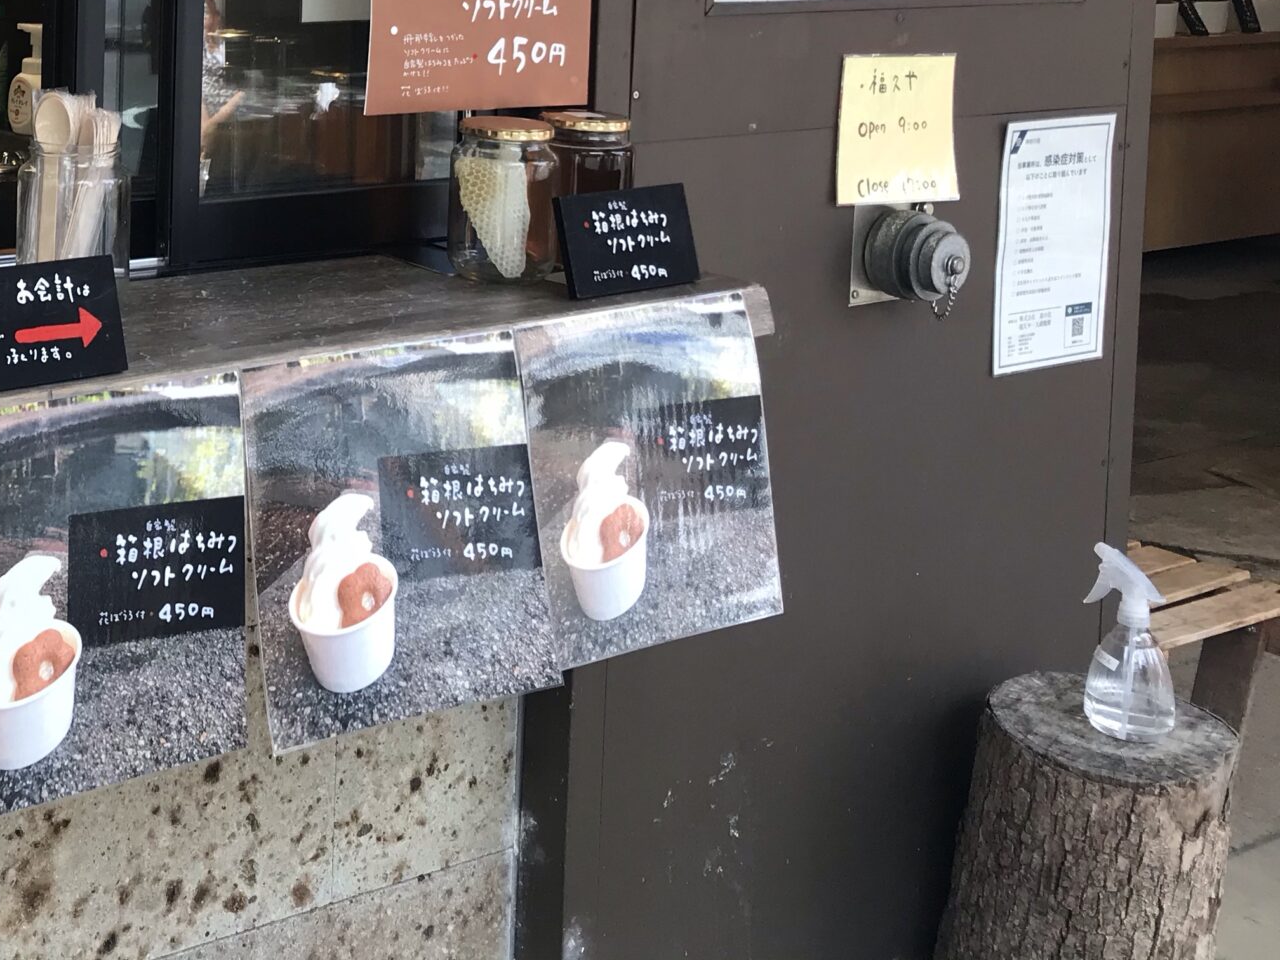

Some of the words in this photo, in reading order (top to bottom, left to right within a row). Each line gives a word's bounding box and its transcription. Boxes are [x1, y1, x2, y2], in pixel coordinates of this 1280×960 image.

[487, 35, 567, 77] 450円
[857, 121, 887, 140] Open
[897, 115, 929, 135] 9:00
[856, 177, 890, 198] Close
[591, 208, 668, 235] 箱根はちみつ
[607, 230, 671, 254] ソフトクリーム
[631, 264, 668, 281] 450円
[16, 272, 91, 305] お会計は
[668, 422, 759, 452] 箱根はちみつ
[681, 447, 758, 473] ソフトクリーム
[419, 474, 526, 506] 箱根はちみつ
[704, 485, 748, 501] 450円
[436, 501, 526, 530] ソフトクリーム
[116, 529, 238, 566] 箱根はちみつ
[463, 542, 514, 562] 450円
[131, 557, 234, 591] ソフトクリーム
[158, 603, 215, 624] 450円
